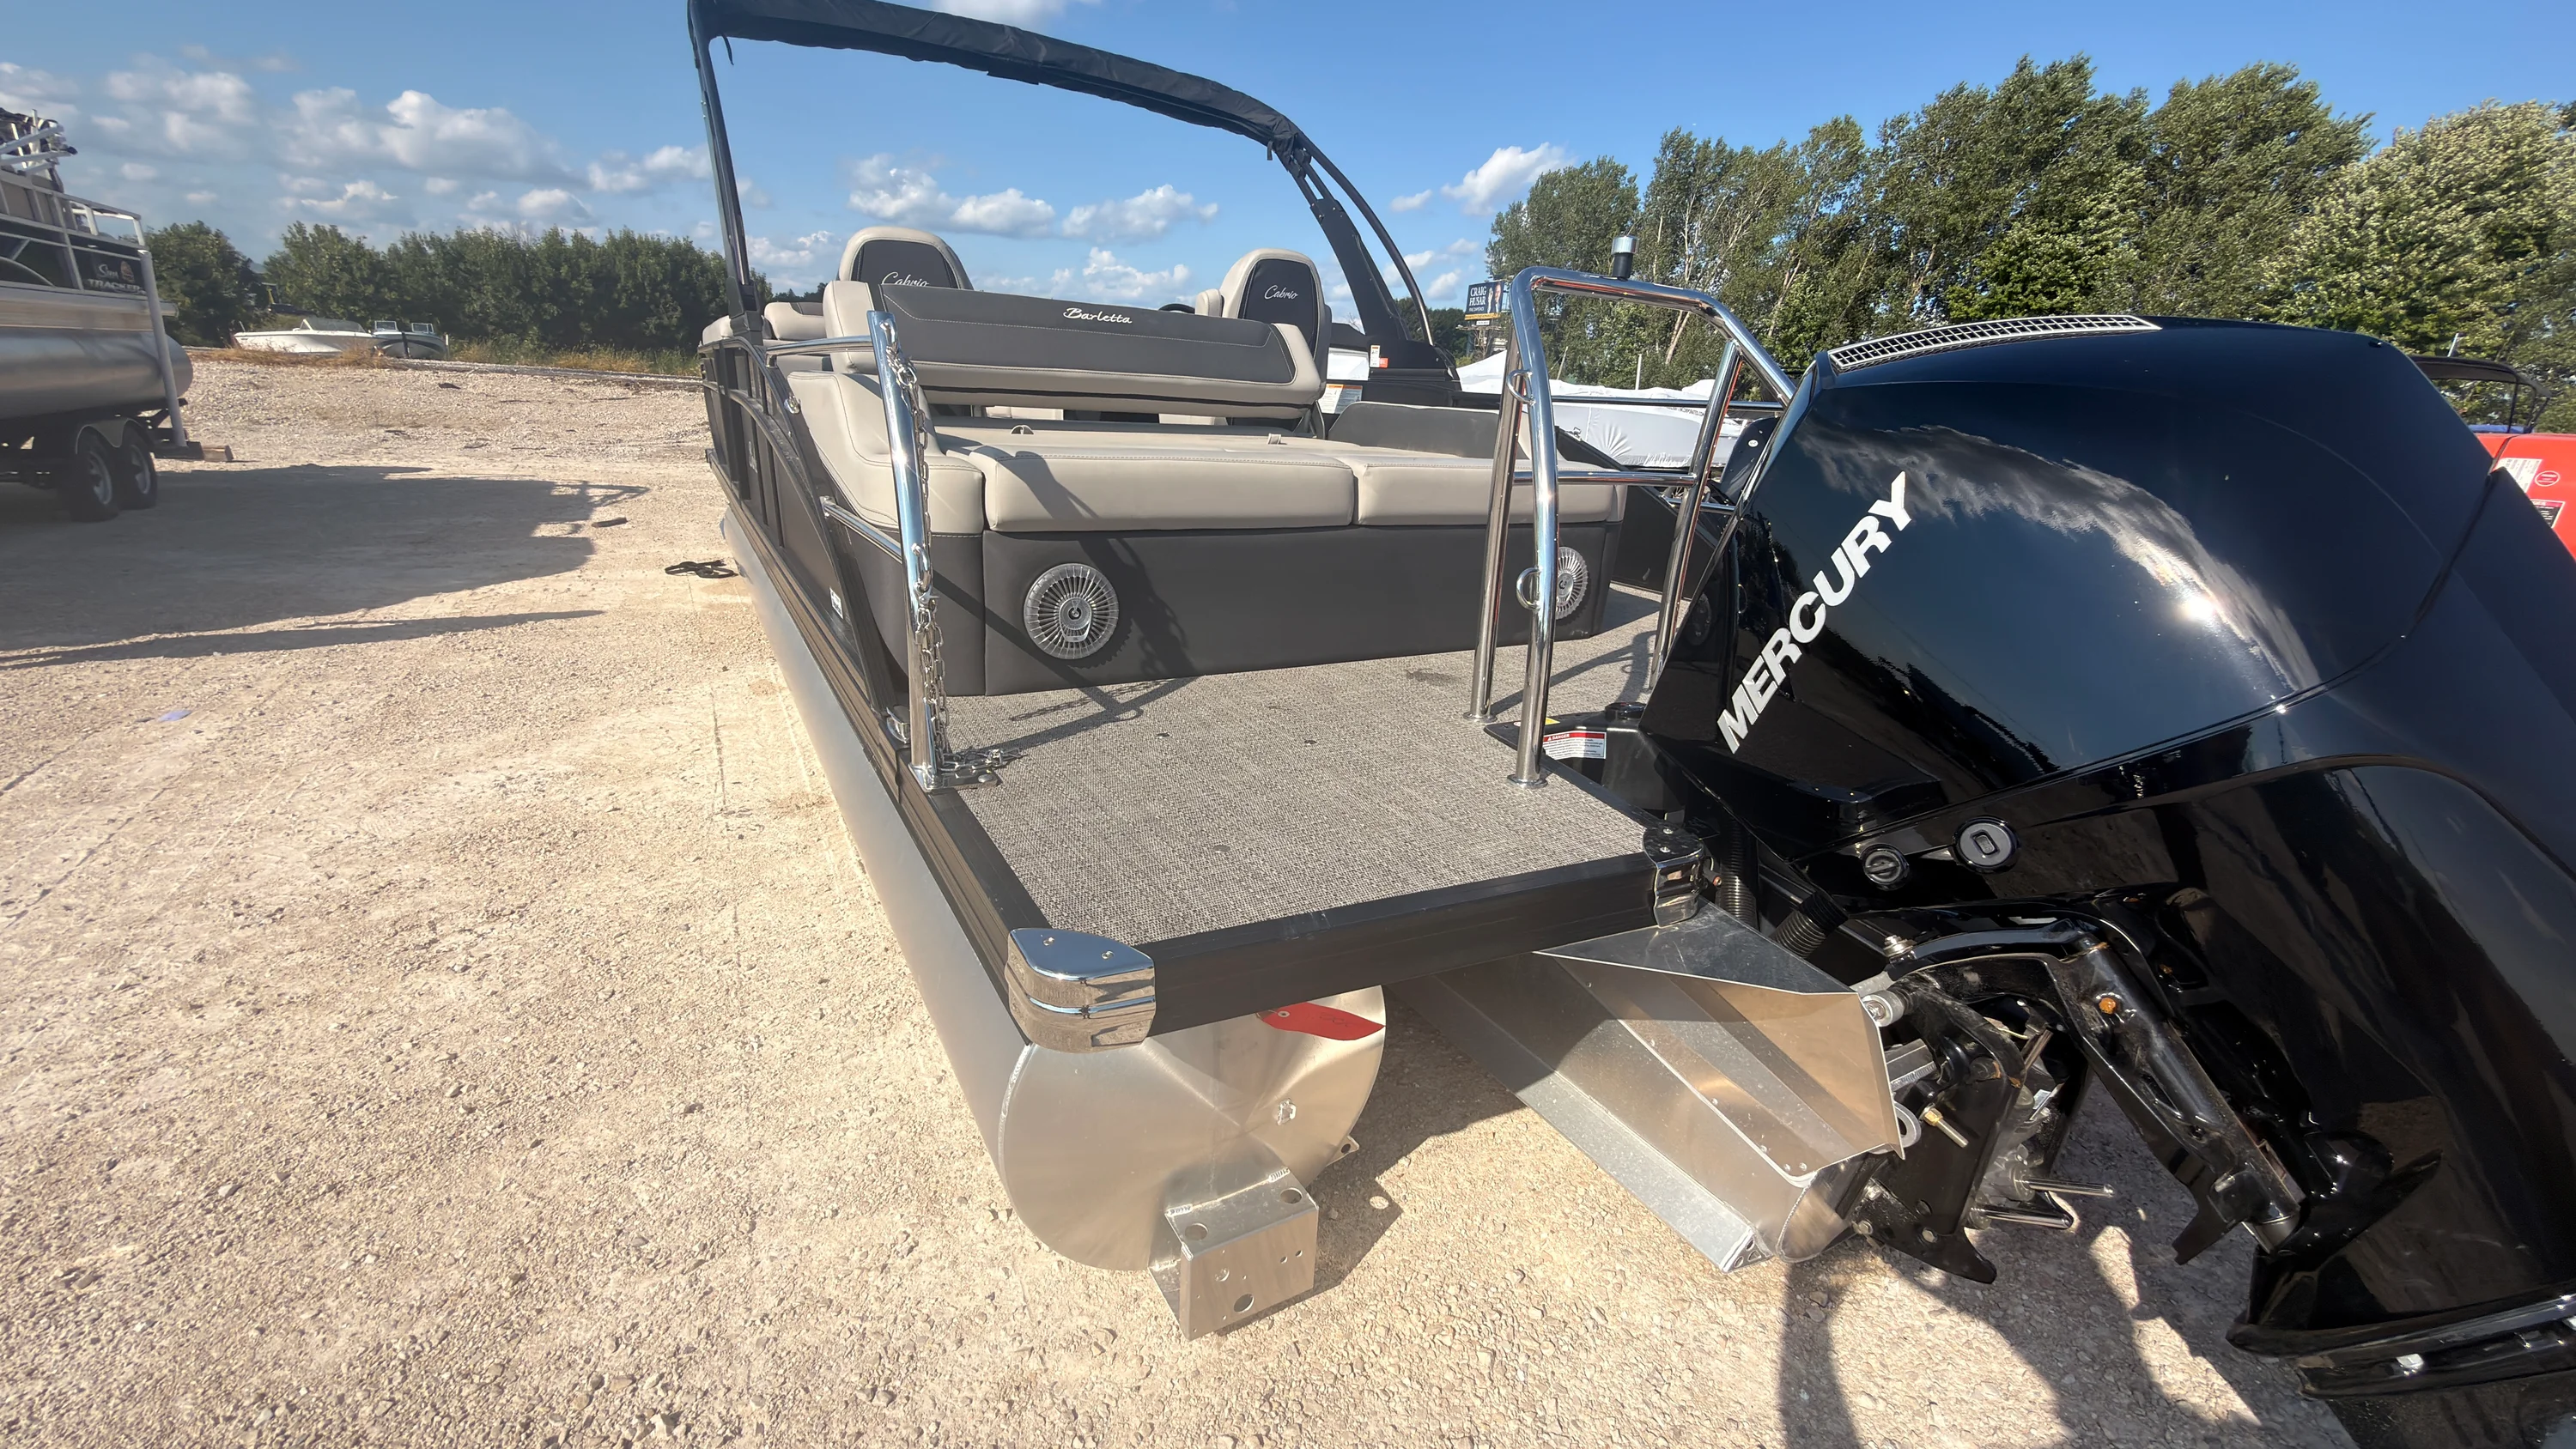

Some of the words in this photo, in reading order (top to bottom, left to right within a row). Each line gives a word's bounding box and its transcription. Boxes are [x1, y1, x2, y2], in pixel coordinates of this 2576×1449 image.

[881, 271, 929, 287] Cabrio
[1264, 284, 1298, 300] Cabrio
[1470, 286, 1487, 296] CRAIG
[1469, 296, 1486, 306] HUSAR
[1063, 307, 1132, 324] Barletta
[1717, 471, 1912, 754] MERCURY
